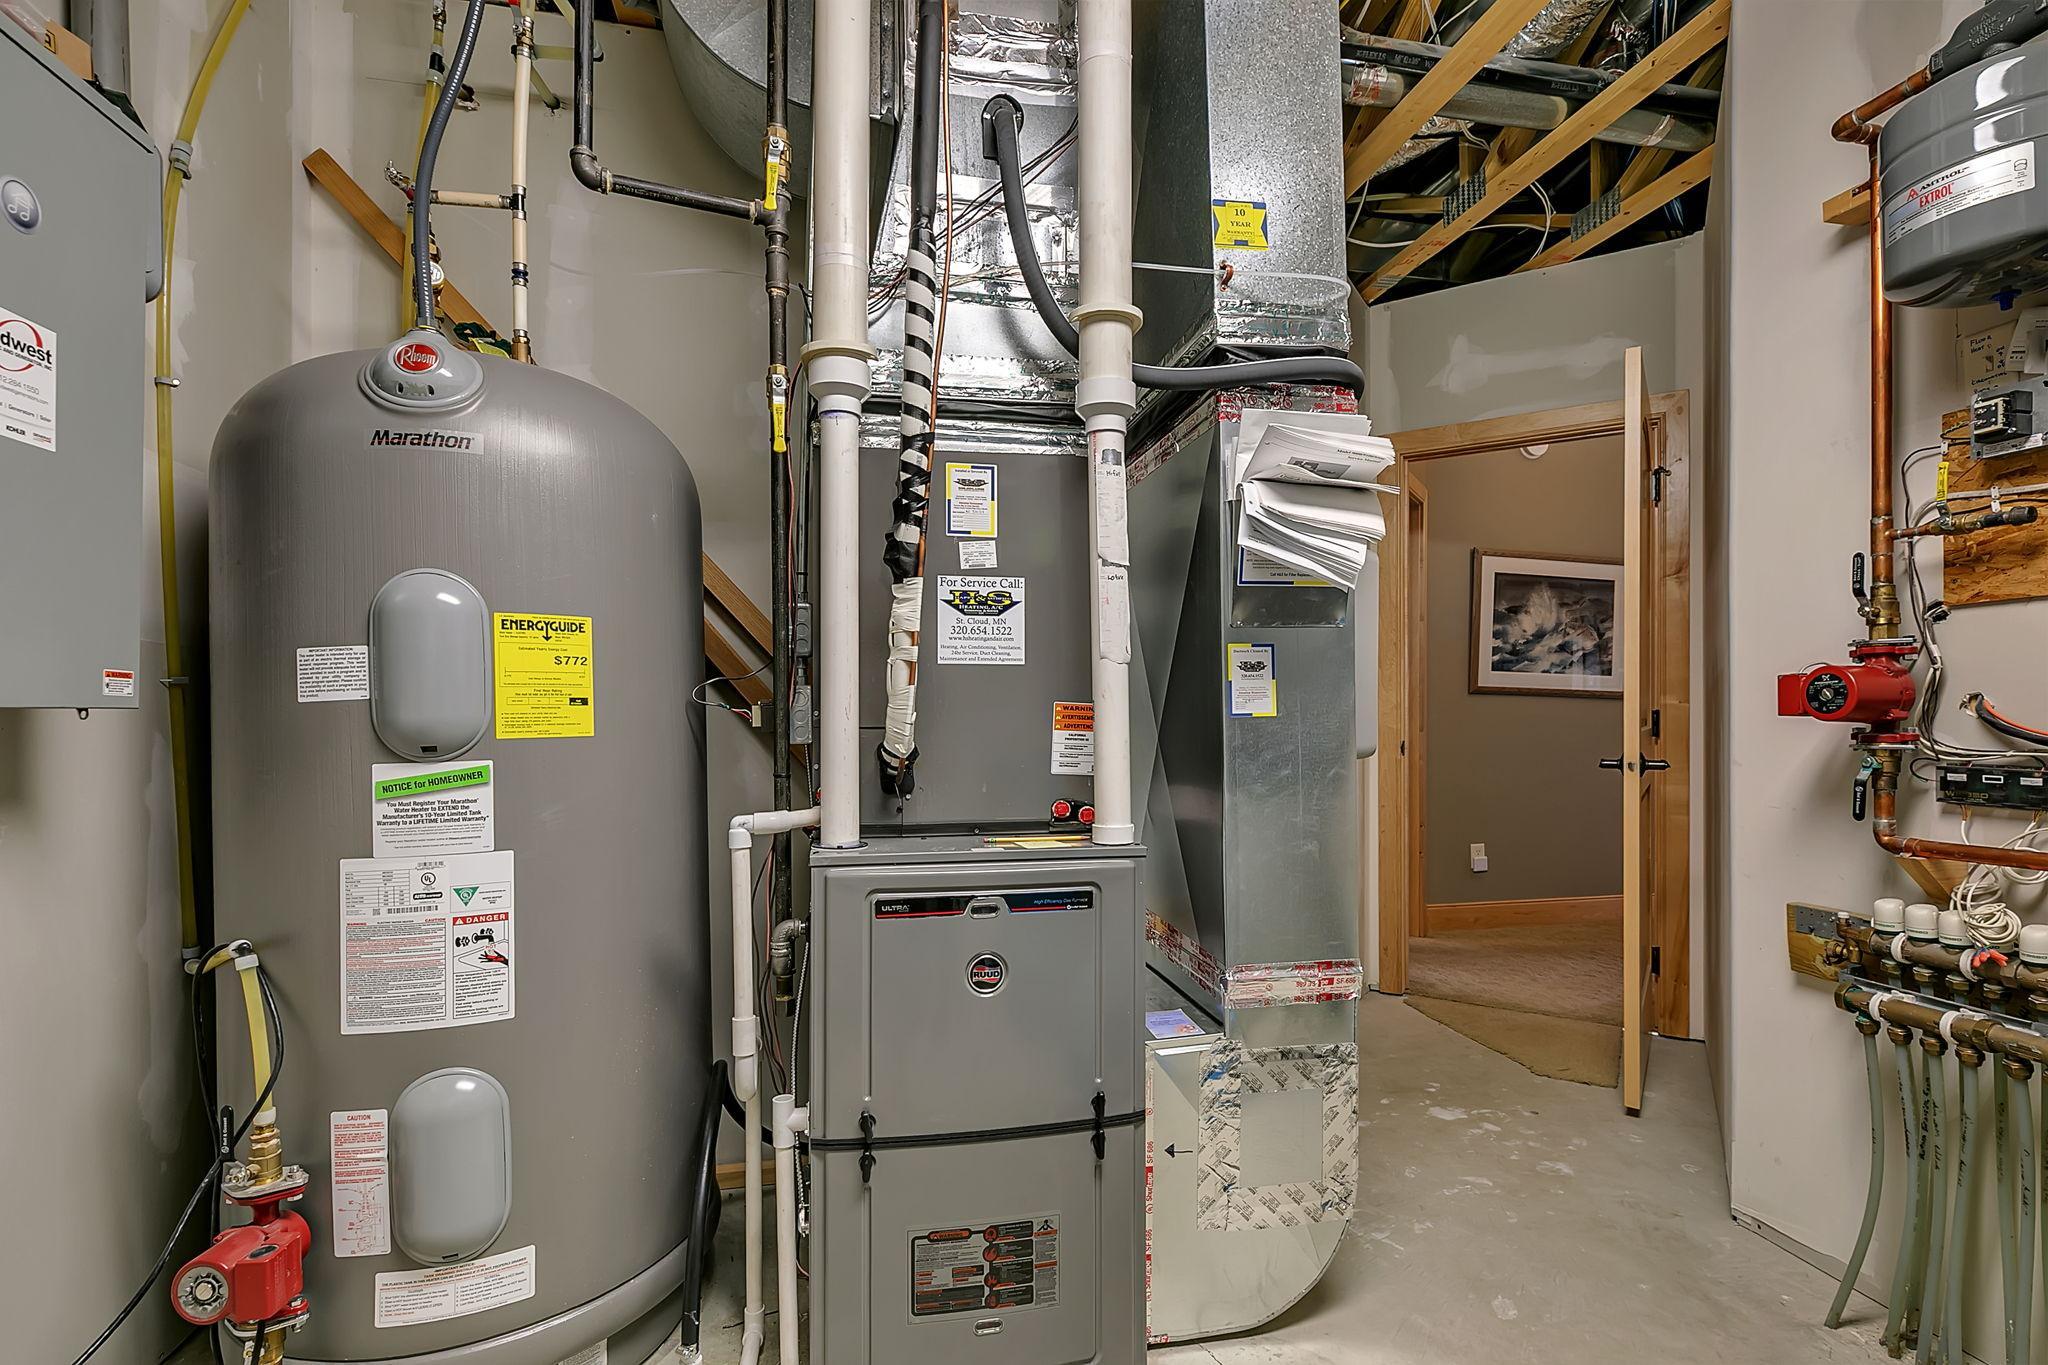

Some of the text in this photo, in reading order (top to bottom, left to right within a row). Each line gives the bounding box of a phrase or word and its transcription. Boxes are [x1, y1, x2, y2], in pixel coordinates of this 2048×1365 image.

[1920, 184, 1953, 208] EXTROL
[400, 344, 436, 366] Rheem
[370, 430, 472, 450] Marathon
[940, 577, 1023, 588] For Service Call:
[501, 619, 586, 634] ENERGYGUIDE
[951, 626, 1012, 635] 320.654.1522
[382, 771, 483, 794] NOTICE for HOMEOWNER
[465, 913, 506, 924] DANGER
